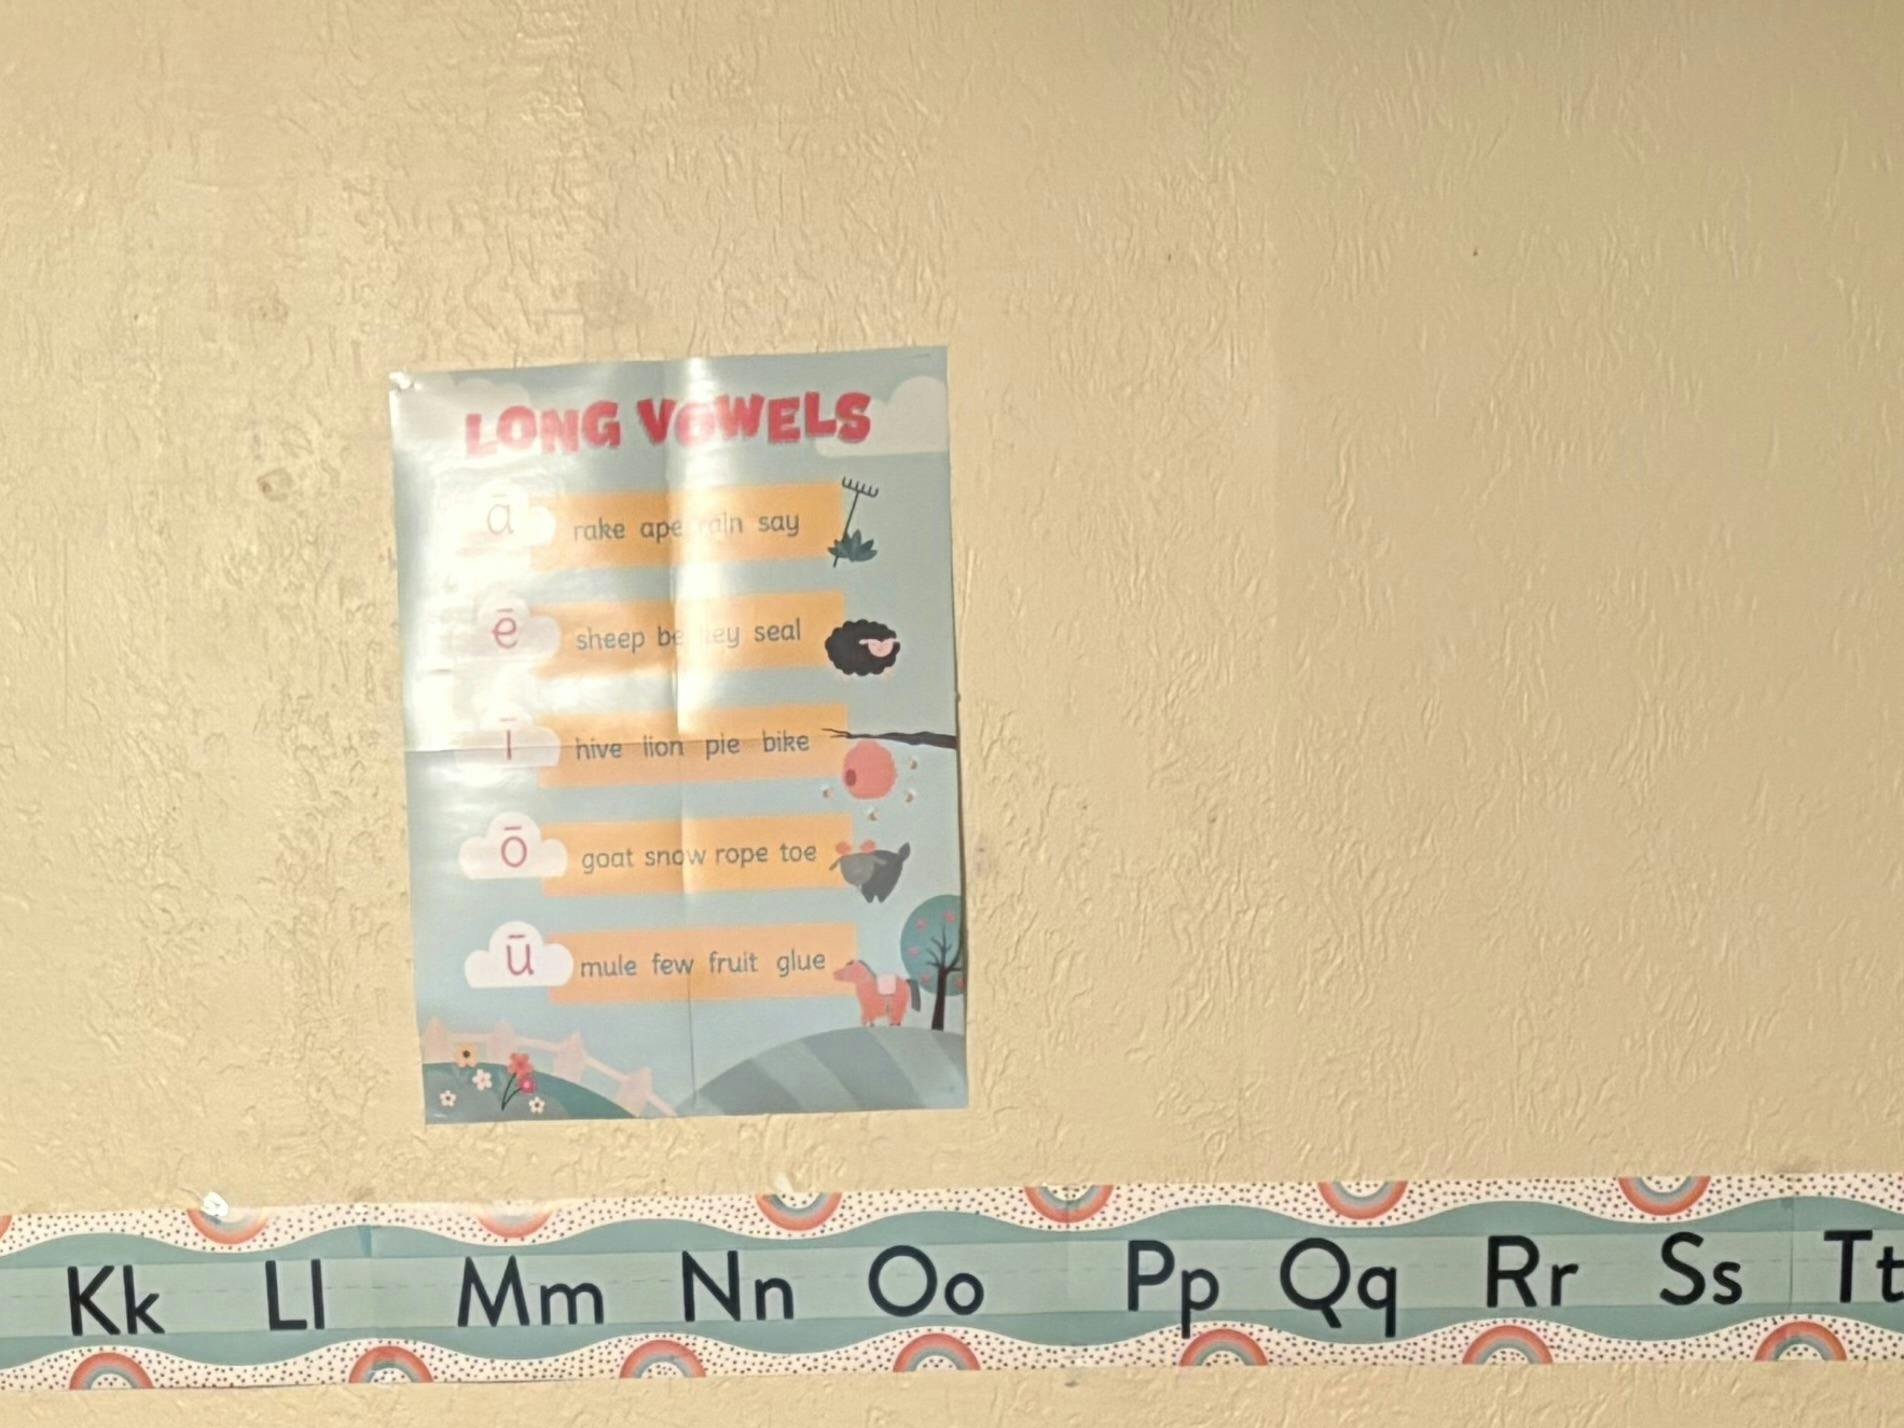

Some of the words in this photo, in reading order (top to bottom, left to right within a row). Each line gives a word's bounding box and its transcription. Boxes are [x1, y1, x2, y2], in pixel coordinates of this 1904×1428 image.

[465, 399, 620, 457] LONG
[636, 392, 871, 446] VOWELS
[574, 515, 626, 543] rake
[640, 516, 683, 546] ape
[697, 509, 744, 535] ain
[759, 515, 799, 537] say
[577, 628, 645, 655] sheep
[755, 617, 800, 642] seal
[575, 735, 623, 762] hive
[643, 736, 684, 757] lion
[706, 732, 741, 761] pie
[762, 730, 809, 752] bike
[582, 848, 634, 874] goat
[645, 848, 706, 866] snow
[716, 840, 769, 871] rope
[779, 843, 816, 862] toe
[581, 954, 637, 977] mule
[652, 953, 694, 976] few
[709, 951, 758, 975] fruit
[777, 948, 825, 978] glue
[68, 1265, 165, 1336] Kk
[265, 1259, 324, 1331] Ll
[458, 1255, 603, 1327] Mm
[682, 1250, 793, 1322] Nn
[869, 1245, 984, 1317] Oo
[1128, 1240, 1219, 1339] Pp
[1280, 1238, 1396, 1338] Qq
[1487, 1235, 1578, 1308] Rr
[1660, 1232, 1742, 1305] Ss
[1824, 1230, 1904, 1303] Tt
